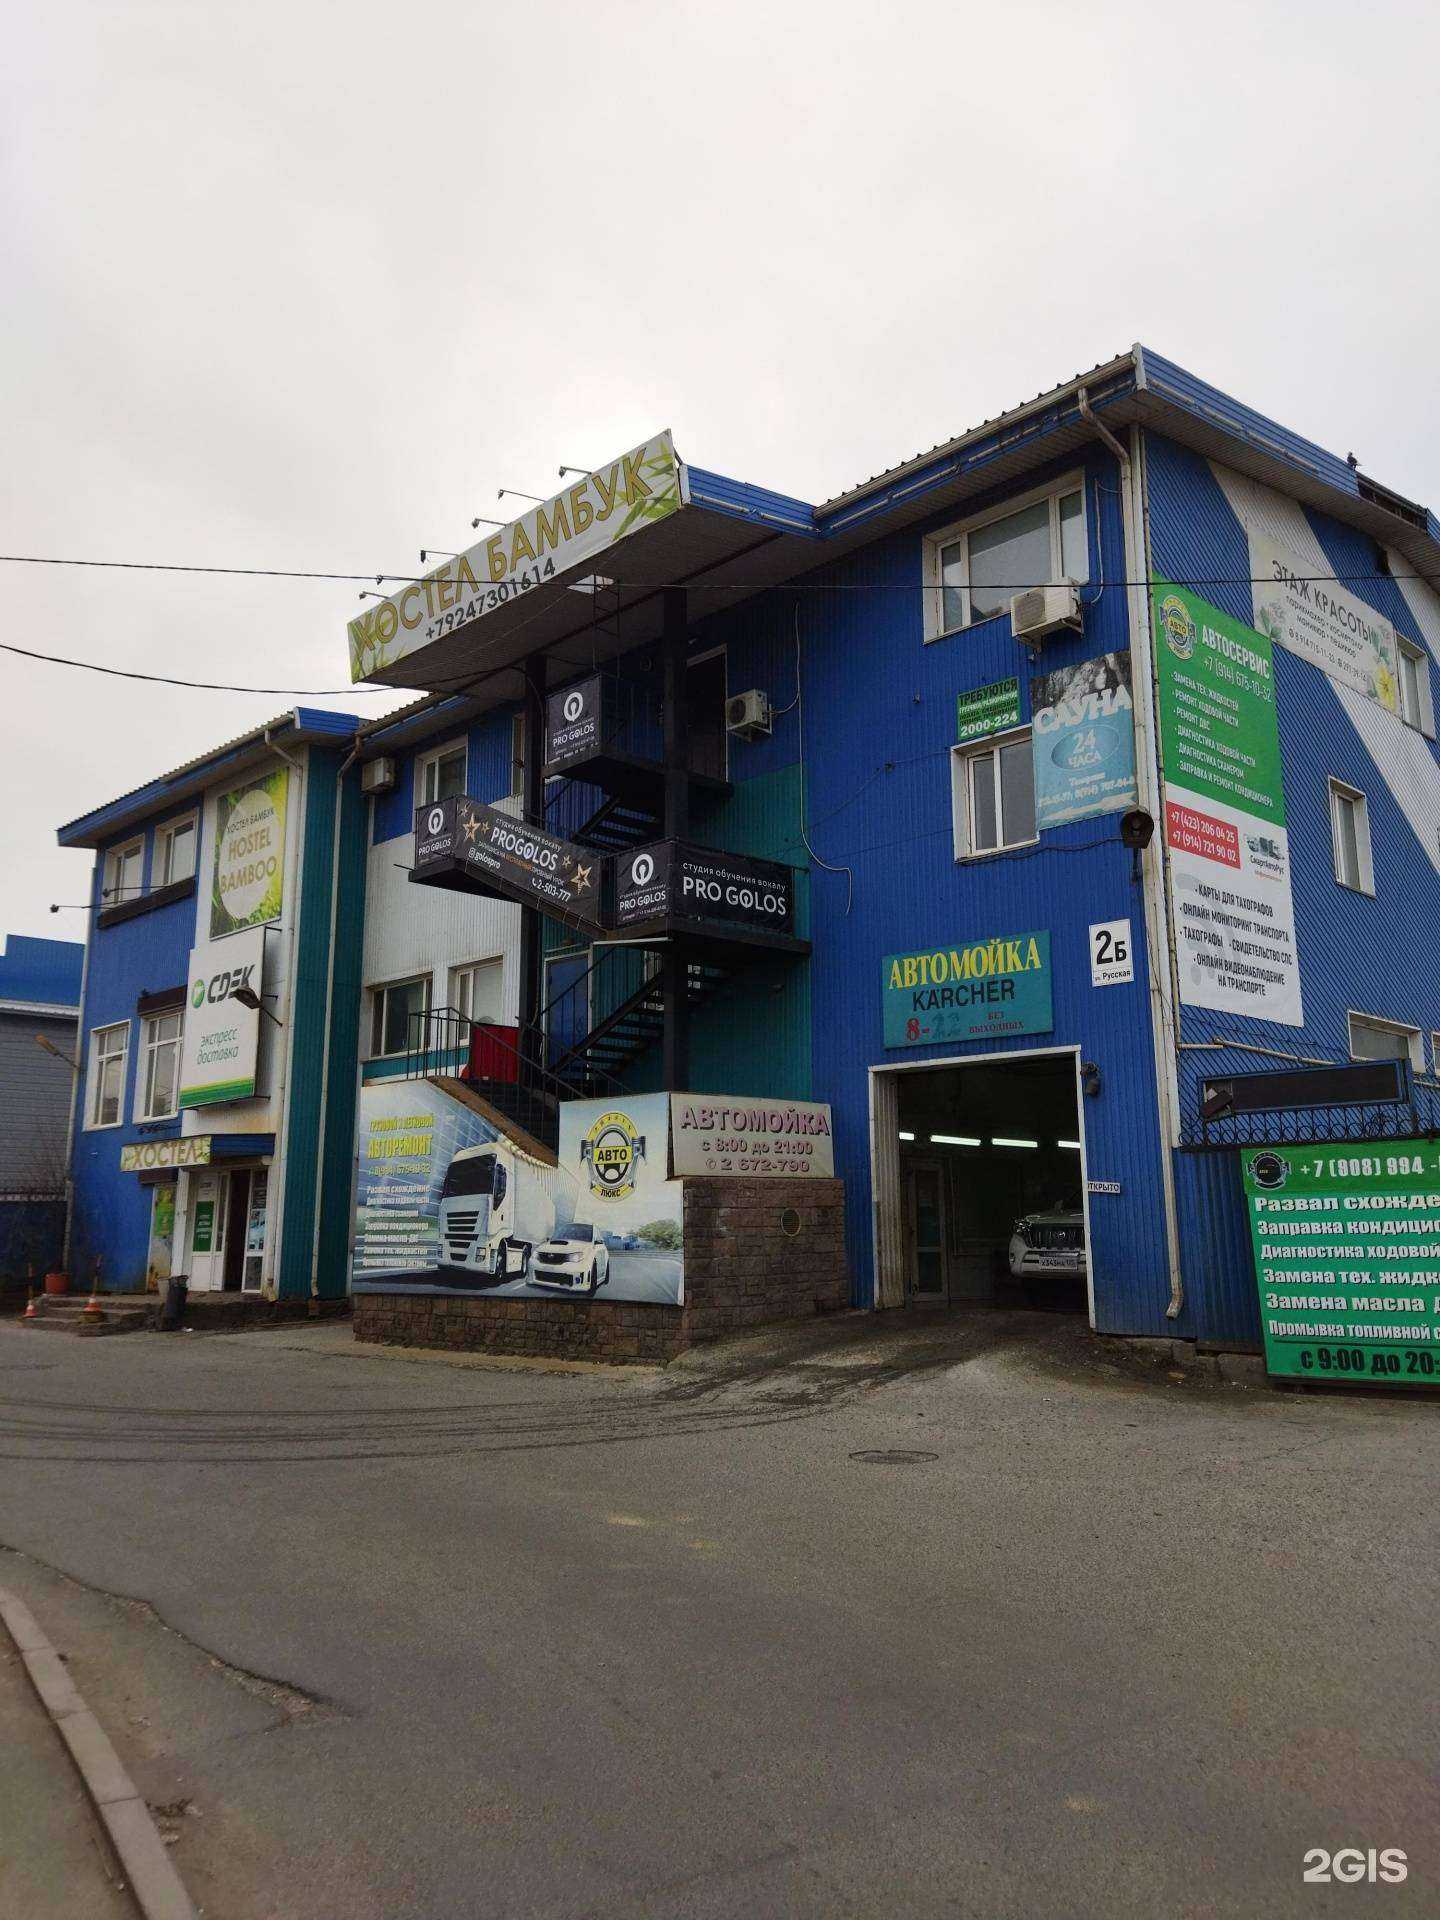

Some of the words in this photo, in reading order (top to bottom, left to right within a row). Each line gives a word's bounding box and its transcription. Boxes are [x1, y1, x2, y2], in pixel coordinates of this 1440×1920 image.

[354, 556, 480, 651] ХОСТЕЛ
[486, 447, 653, 583] БАМБУК
[1272, 560, 1311, 602] ЭТАЖ
[1314, 587, 1373, 644] КРАСОТЫ
[1202, 624, 1270, 680] АВТОСЕРВИС
[959, 679, 1018, 705] ТРЕБУЮТСЯ
[1175, 689, 1197, 707] РЕМОНТ
[1033, 684, 1133, 734] САУНА
[1176, 707, 1198, 724] РЕМОНТ
[553, 734, 568, 748] PRO
[569, 722, 595, 740] GOLOS
[960, 711, 1018, 737] 2000-224
[1177, 725, 1215, 750] ДИАГНОСТИКА
[1068, 750, 1101, 768] ЧАСА
[1178, 742, 1217, 767] ДИАГНОСТИКА
[1179, 760, 1208, 780] ЗАПРАВКА
[1213, 774, 1234, 791] РЕМОНТ
[1180, 811, 1200, 832] (423)
[1200, 820, 1214, 837] 206
[1225, 831, 1235, 844] 25
[228, 826, 272, 862] HOSTEL
[418, 844, 430, 856] PRO
[431, 838, 451, 851] GOLOS
[490, 827, 559, 871] PROGOLOS
[1182, 831, 1201, 851] (914)
[1227, 849, 1237, 862] 02
[220, 855, 277, 893] BAMBOO
[682, 862, 714, 876] студия
[715, 869, 756, 885] обучения
[757, 879, 786, 894] вокалу
[537, 879, 571, 902] 2-503-777
[619, 898, 636, 911] PRO
[637, 890, 666, 906] GOLOS
[683, 876, 722, 901] PRO
[725, 886, 787, 916] GOLOS
[1198, 883, 1221, 902] КАРТЫ
[1222, 890, 1235, 907] ДЛЯ
[1235, 895, 1273, 918] ТАХОГРАФОВ
[1183, 900, 1211, 922] ОНЛАЙН
[1211, 910, 1252, 935] МОНИТОРИНГ
[1253, 922, 1290, 944] ТРАНСПОРТА
[1183, 926, 1223, 948] ТАХОГРАФЫ
[1232, 938, 1281, 963] СВИДЕТЕЛЬСТВО
[888, 937, 1042, 990] АВТОМОЙКА
[1102, 970, 1131, 981] Русская
[1196, 952, 1224, 972] ОНЛАЙН
[1224, 956, 1285, 985] ВИДЕОНАБЛЮДЕНИЕ
[1217, 974, 1227, 988] НА
[1227, 975, 1266, 997] ТРАНСПОРТЕ
[197, 1046, 239, 1065] доставка
[681, 1105, 831, 1137] АВТОМОЙКА
[133, 1139, 198, 1167] ХОСТЕЛ
[367, 1135, 433, 1160] АВТОРЕМОНТ
[597, 1149, 628, 1162] АВТО
[715, 1137, 748, 1153] 8:00
[752, 1141, 770, 1156] до
[1386, 1156, 1424, 1175] 994
[600, 1188, 621, 1198] ЛЮКС
[1254, 1197, 1339, 1212] Развал
[1257, 1221, 1344, 1236] Заправка
[1261, 1244, 1364, 1260] Диагностика
[1367, 1242, 1440, 1259] ходовой
[1263, 1269, 1336, 1284] Замена
[1338, 1271, 1376, 1284] тех.
[1266, 1293, 1348, 1311] Замена
[1351, 1297, 1426, 1312] масла
[1268, 1319, 1345, 1336] Промывка
[1347, 1323, 1431, 1340] топливной
[1318, 1347, 1366, 1372] 9:00
[1371, 1353, 1400, 1376] до
